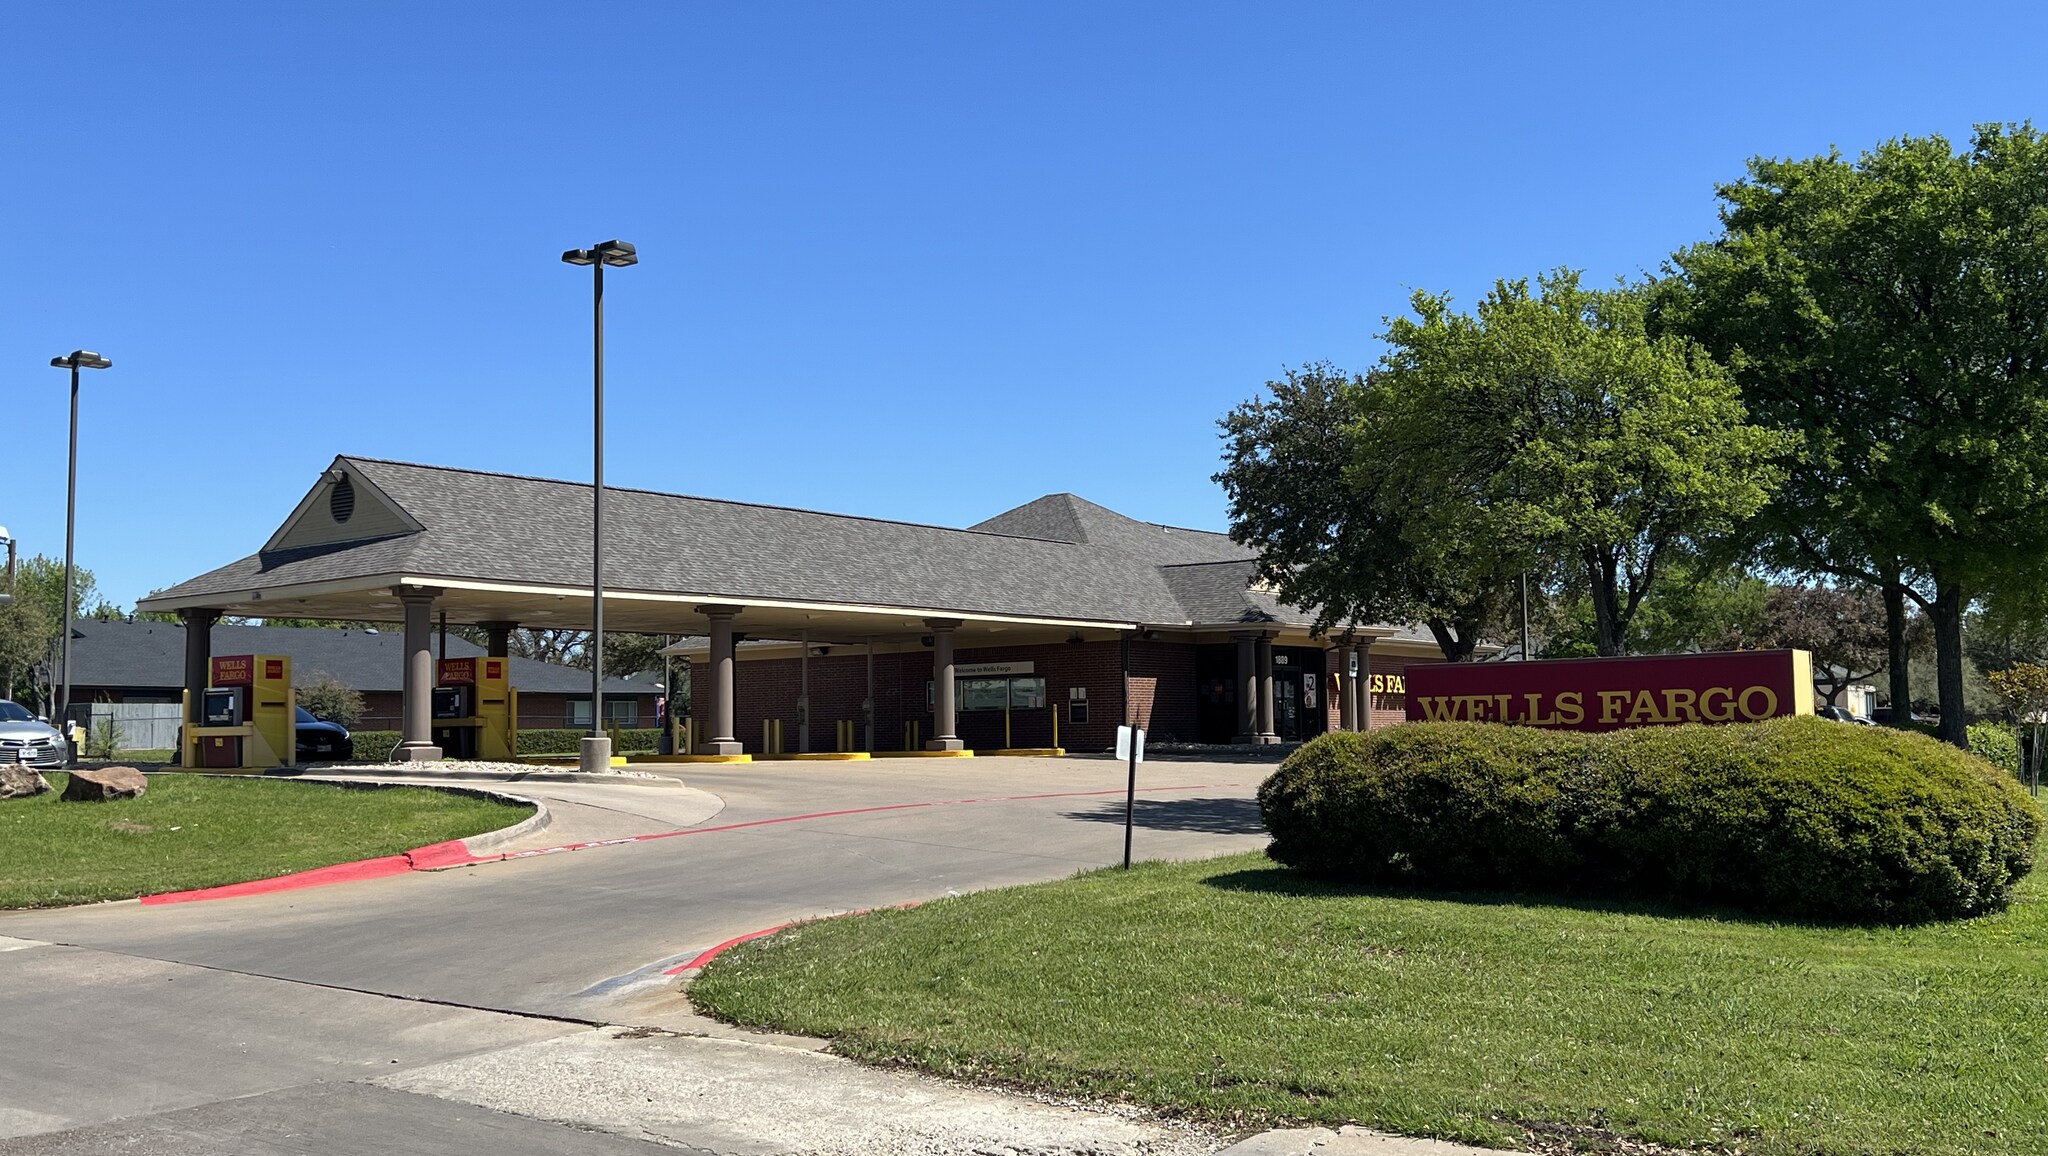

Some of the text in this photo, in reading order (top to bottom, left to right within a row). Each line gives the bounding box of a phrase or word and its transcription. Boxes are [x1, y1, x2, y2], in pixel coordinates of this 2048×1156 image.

[219, 660, 246, 669] WELLS
[444, 662, 469, 671] WELLS
[219, 670, 246, 681] FARGO
[1417, 685, 1778, 725] WELLS FARGO
